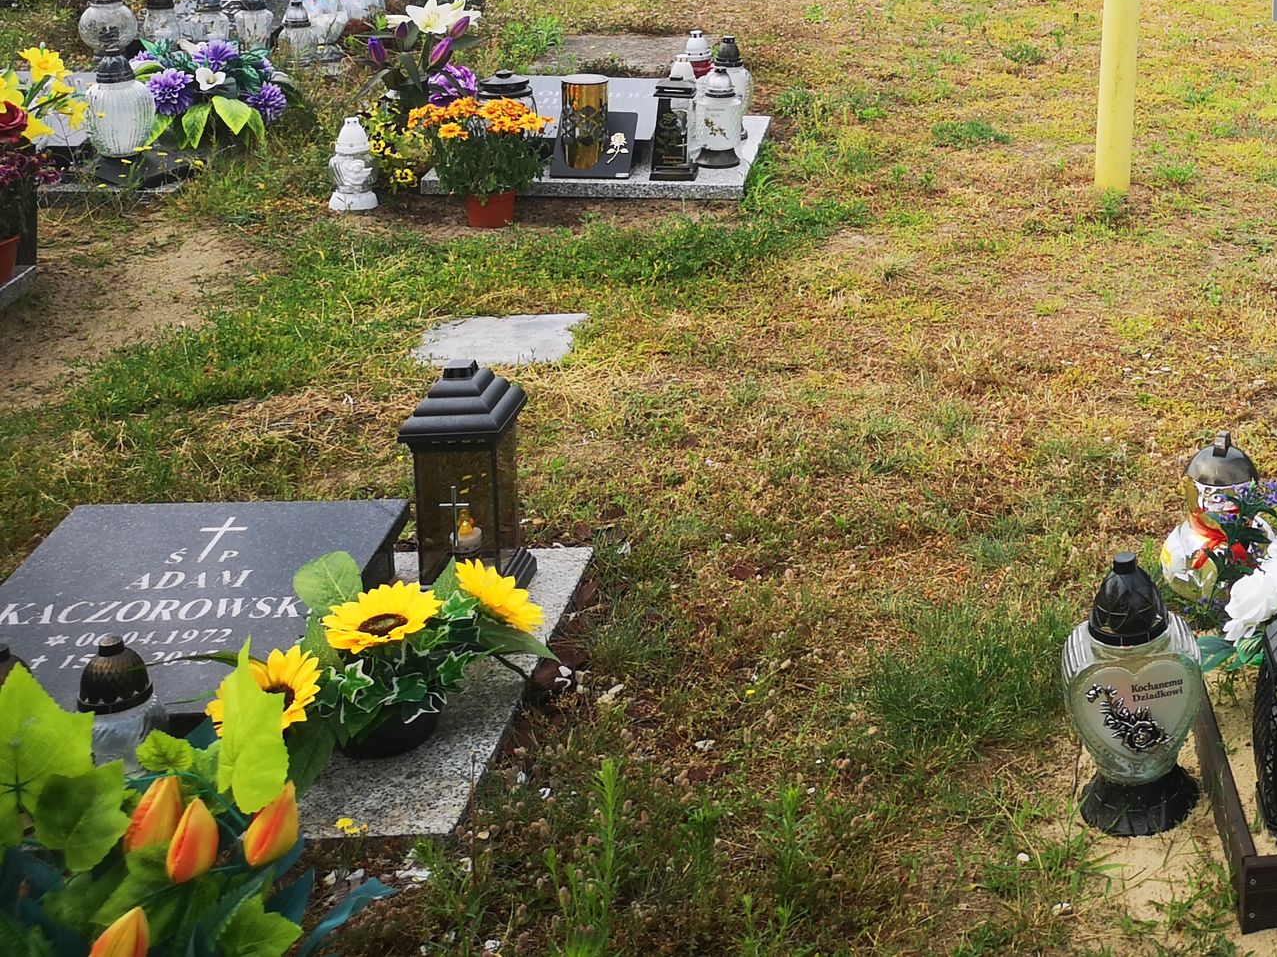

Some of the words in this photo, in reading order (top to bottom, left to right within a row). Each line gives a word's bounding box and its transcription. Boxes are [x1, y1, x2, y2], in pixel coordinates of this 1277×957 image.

[218, 549, 240, 564] P
[125, 568, 254, 590] ADAM
[0, 595, 312, 626] KACZOROWSK
[75, 627, 233, 648] 0604.1972
[1131, 679, 1183, 693] Kochanemu
[1132, 686, 1183, 702] Dziadkowi
